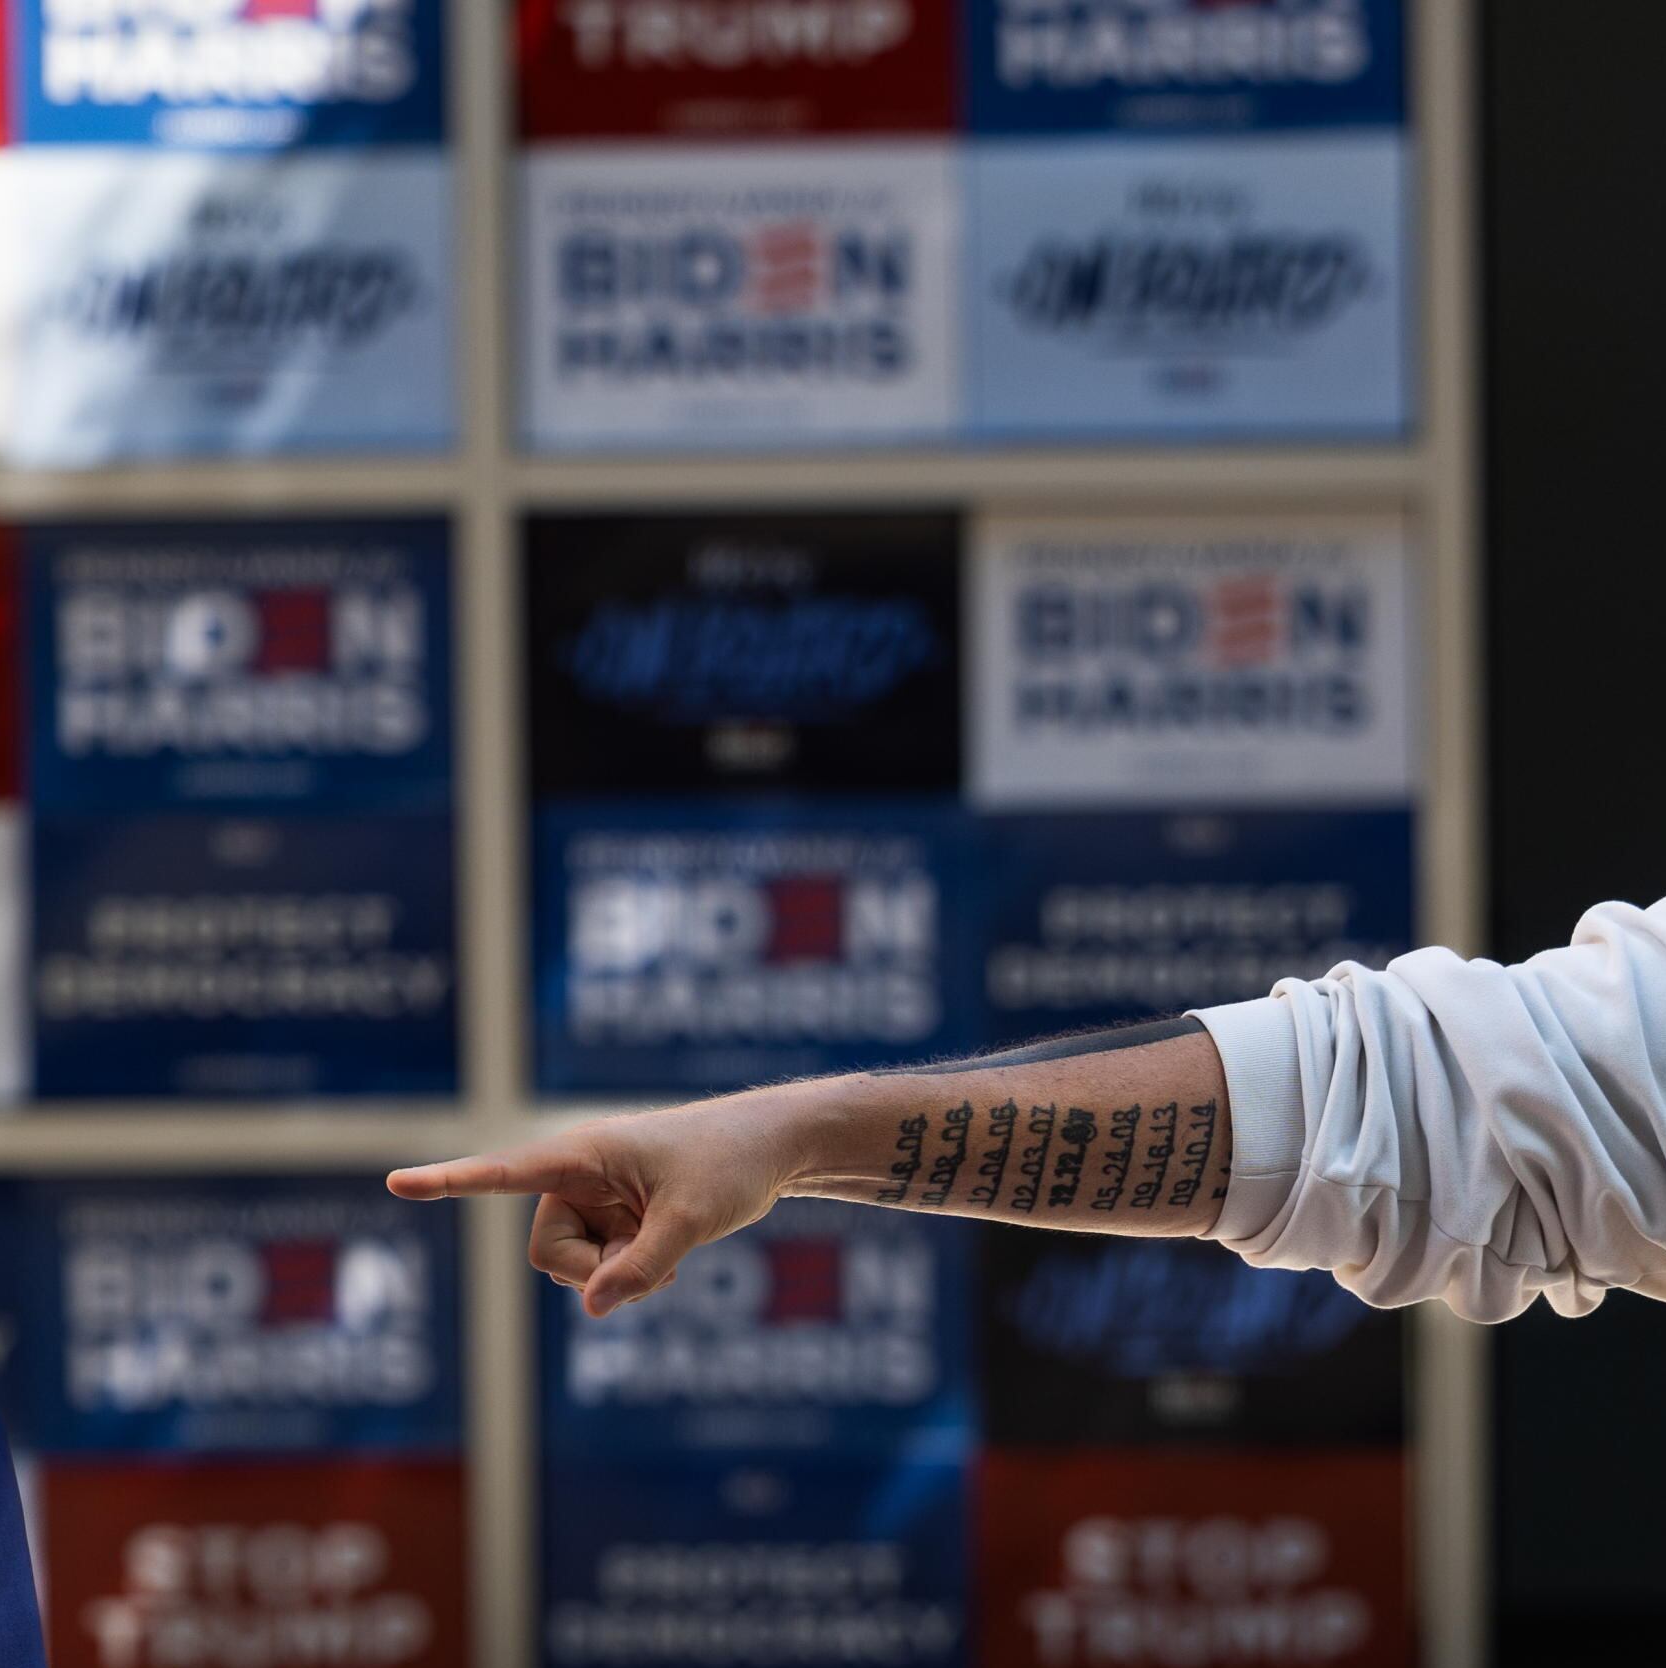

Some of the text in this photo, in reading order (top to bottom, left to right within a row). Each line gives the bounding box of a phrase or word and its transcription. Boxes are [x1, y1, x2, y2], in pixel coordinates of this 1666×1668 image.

[41, 28, 418, 104] HARRIS
[993, 14, 1373, 85] HARRIS
[555, 232, 915, 308] BIDEN
[555, 322, 915, 384] HARRIS
[55, 592, 426, 674] BIDEN
[1016, 587, 1368, 660] BIDEN
[55, 677, 428, 757] HARRIS
[1016, 674, 1369, 736] HARRIS
[567, 878, 937, 962] BIDEN
[567, 974, 939, 1044] HARRIS
[966, 1097, 1019, 1209] 12.04.06
[1010, 1101, 1057, 1214] 02.03.07
[1090, 1102, 1142, 1212] 05.24.08
[1130, 1101, 1178, 1210] 09.16.13
[1168, 1098, 1217, 1209] 09.10.14
[64, 1240, 433, 1326] BIDEN
[63, 1330, 435, 1408] HARRIS
[566, 1333, 937, 1404] HARRIS
[123, 1520, 393, 1592] STOP
[598, 1544, 911, 1598] PROTECT
[1062, 1516, 1333, 1590] STOP
[1021, 1592, 1372, 1668] TRUMP
